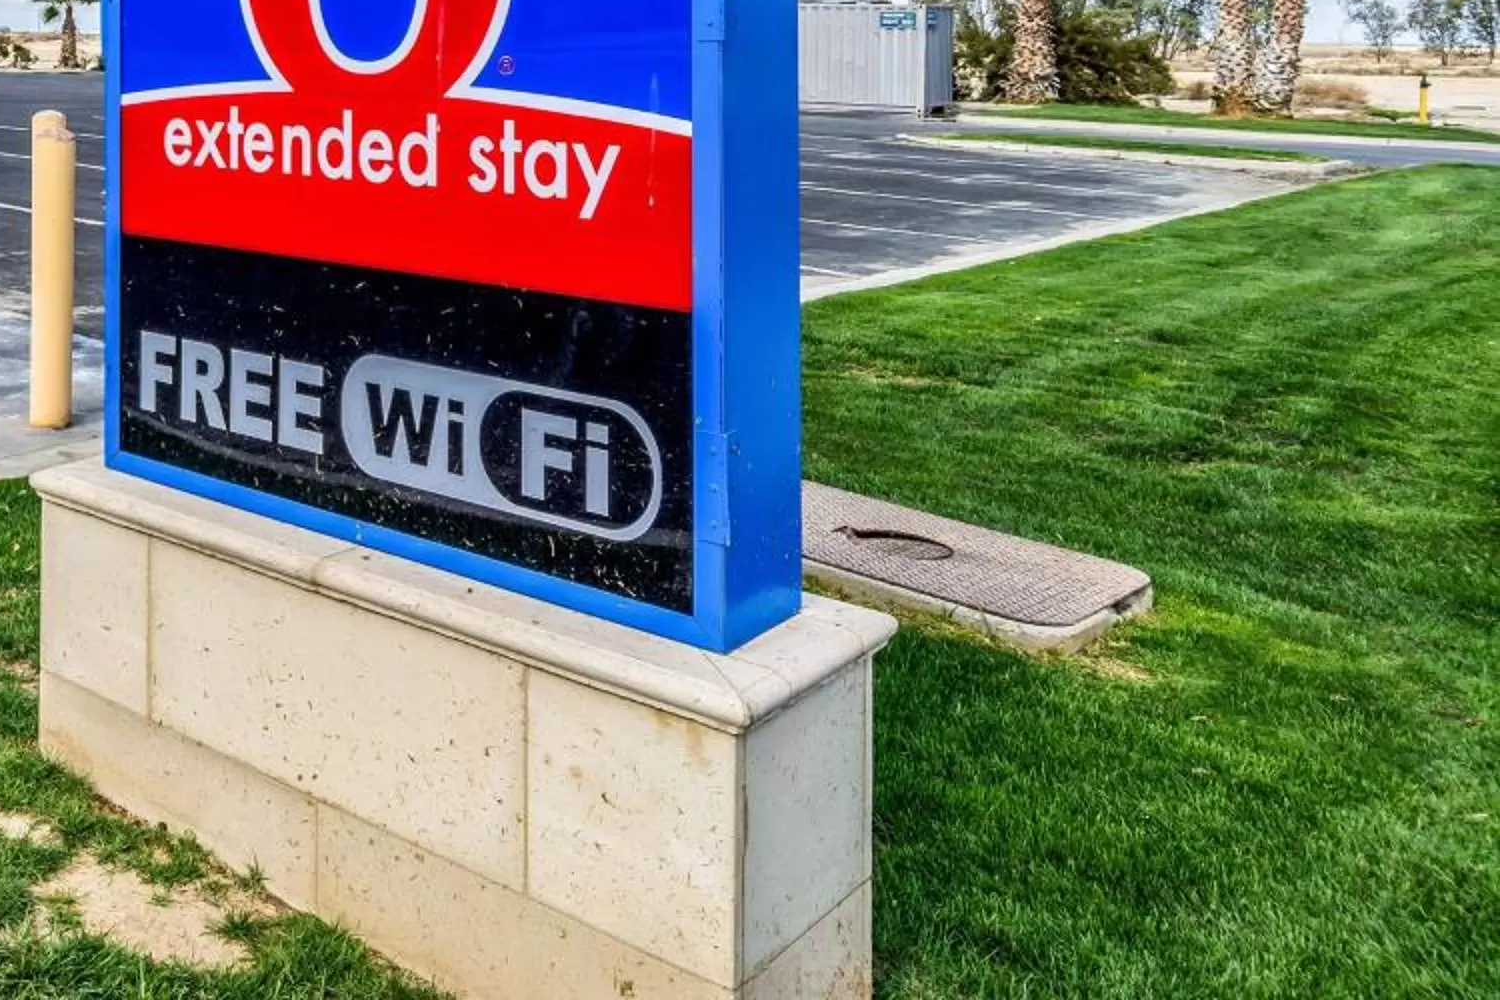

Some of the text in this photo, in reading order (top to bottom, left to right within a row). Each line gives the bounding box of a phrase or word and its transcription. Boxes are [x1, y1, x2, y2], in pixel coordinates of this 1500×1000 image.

[163, 106, 621, 219] extended stay
[139, 330, 324, 455] FREE
